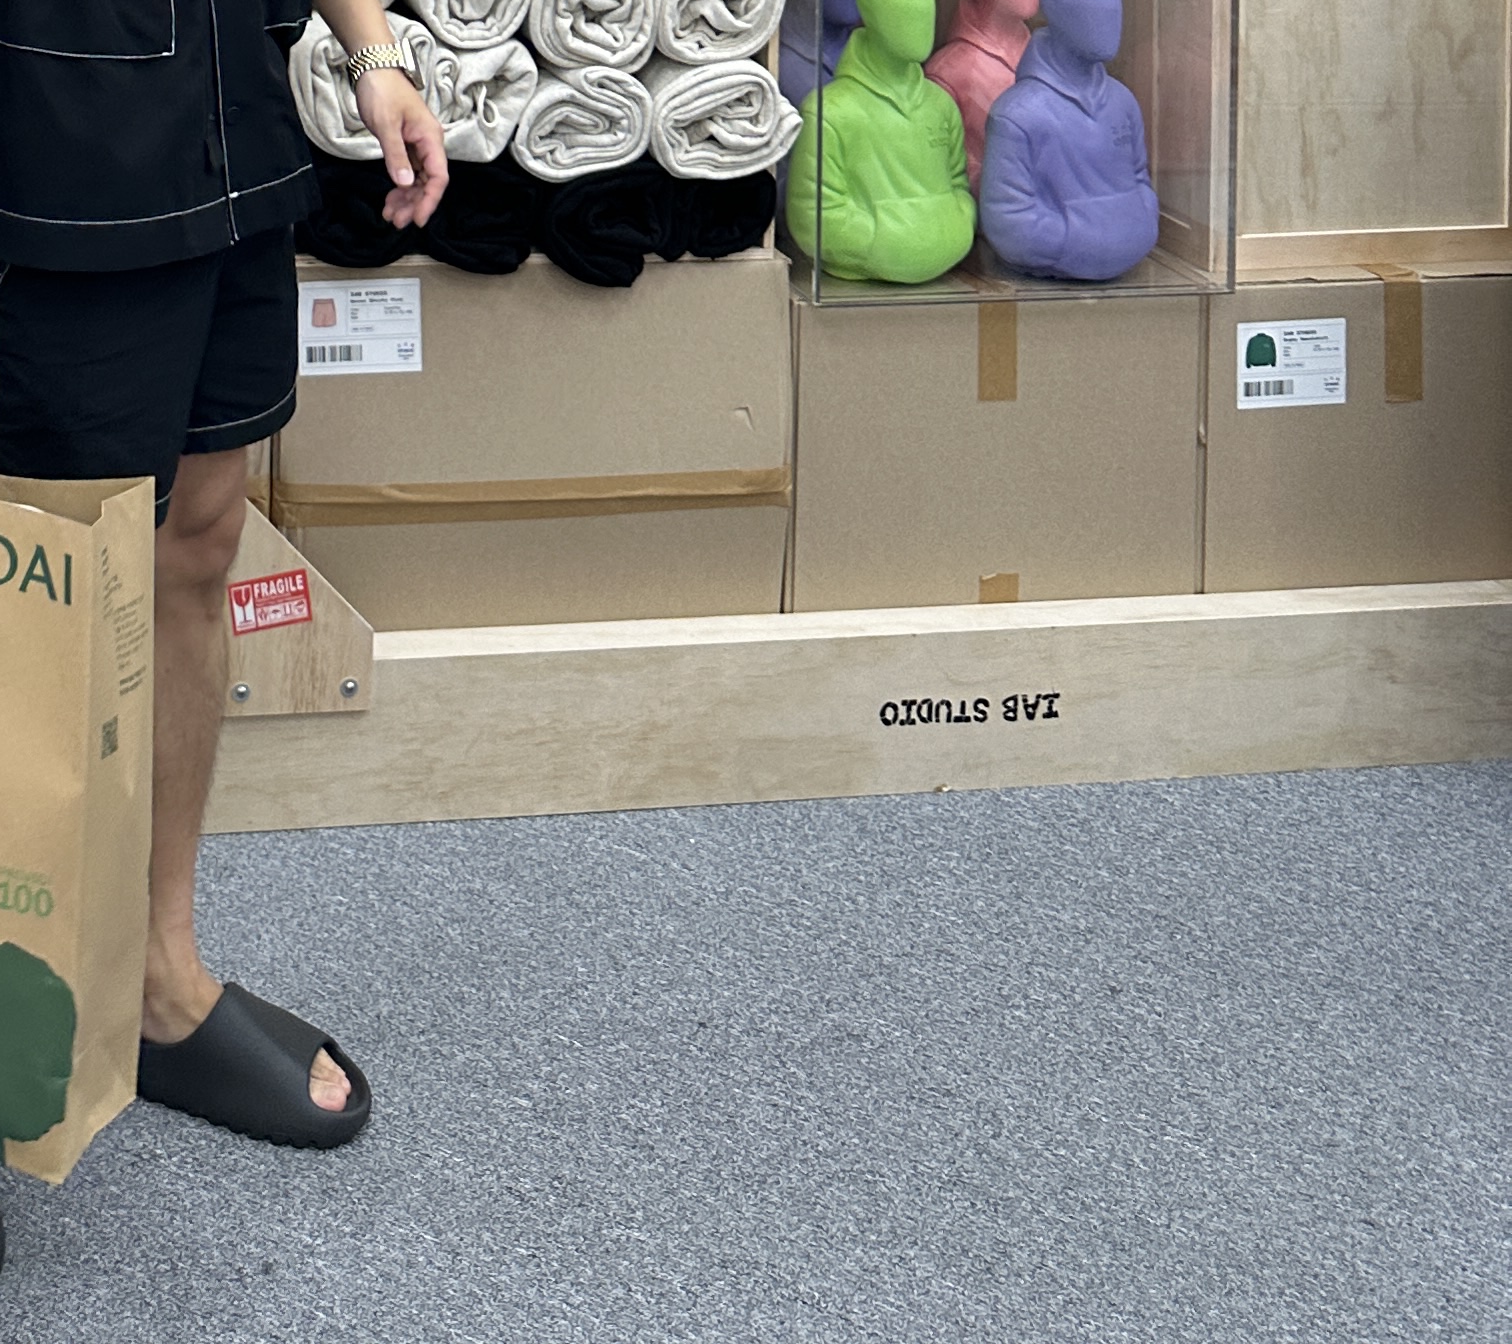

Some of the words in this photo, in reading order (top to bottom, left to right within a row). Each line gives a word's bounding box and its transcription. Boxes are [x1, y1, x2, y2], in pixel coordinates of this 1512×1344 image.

[253, 574, 305, 599] FRAGILE
[879, 697, 991, 726] STUDIO
[1001, 692, 1061, 722] IAB
